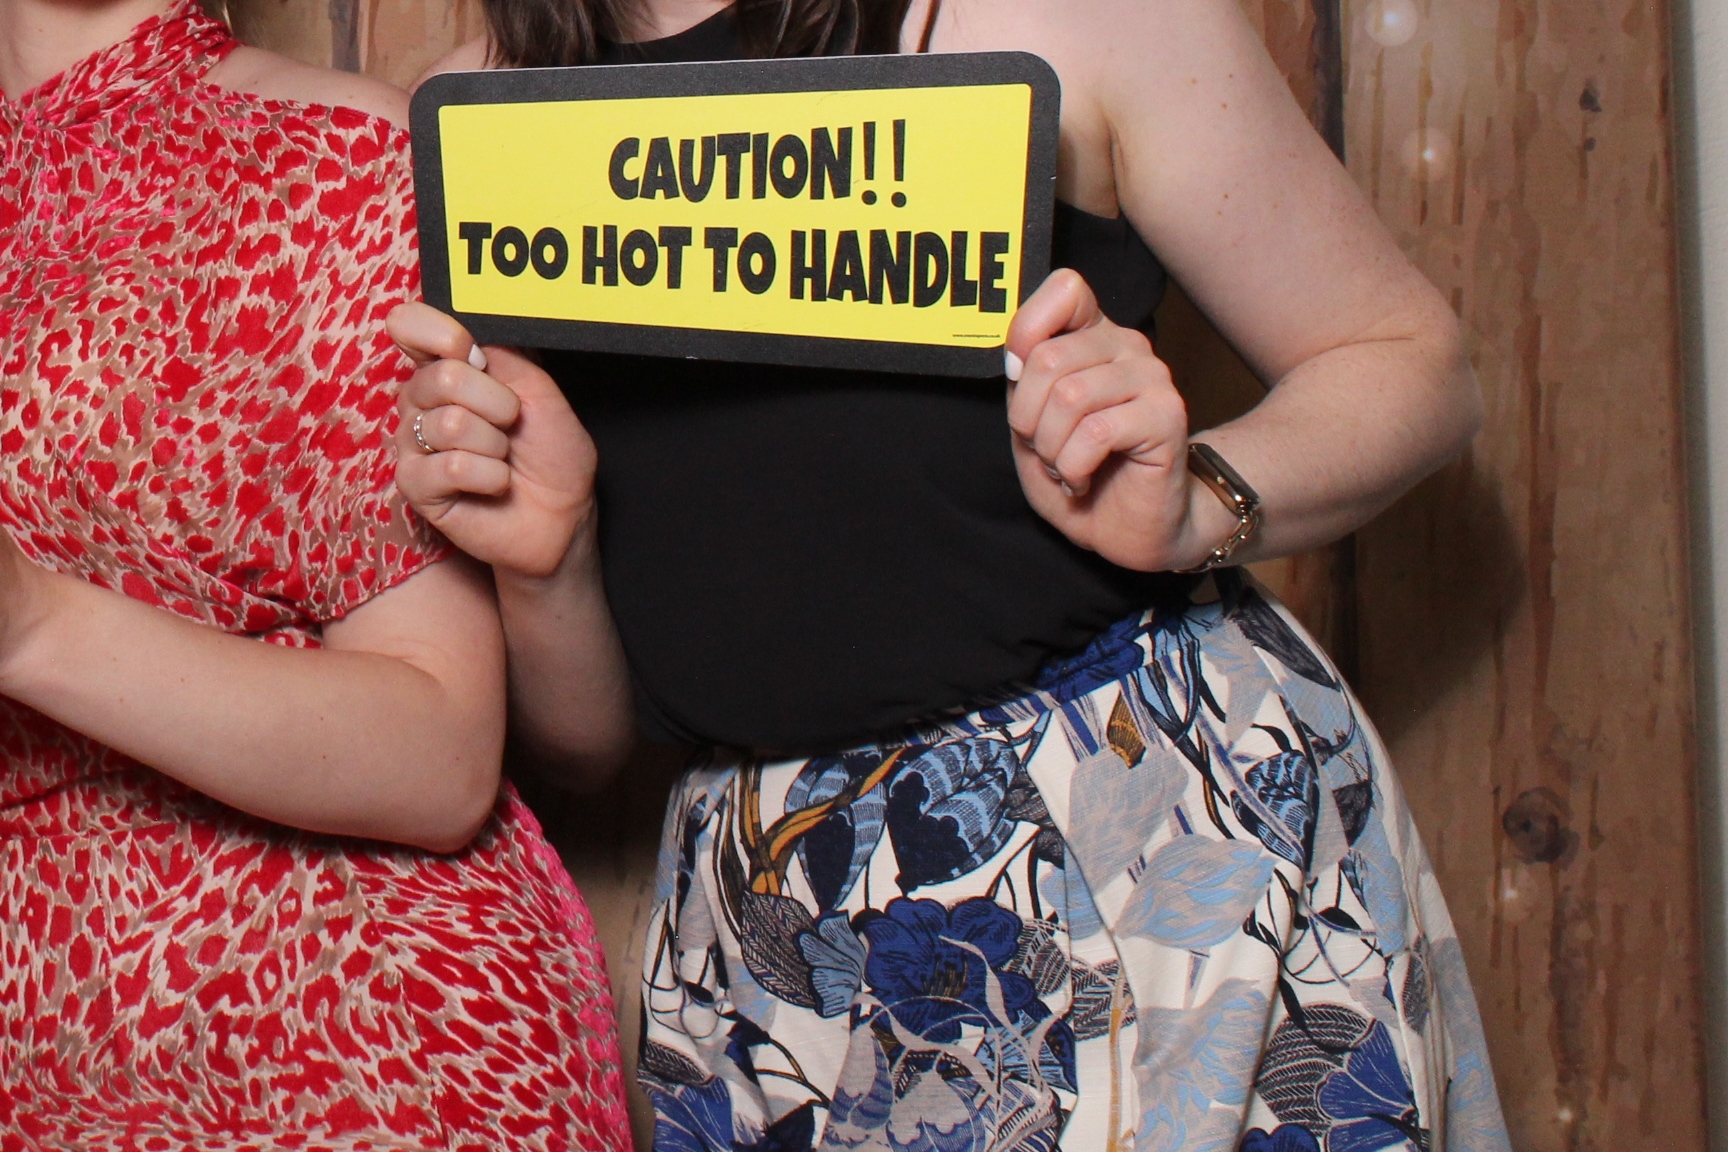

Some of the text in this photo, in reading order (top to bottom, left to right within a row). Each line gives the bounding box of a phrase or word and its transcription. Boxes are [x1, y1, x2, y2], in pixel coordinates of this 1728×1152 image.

[609, 119, 907, 207] CAUTION!!
[459, 222, 1010, 313] TOO HOT TO HANDLE
